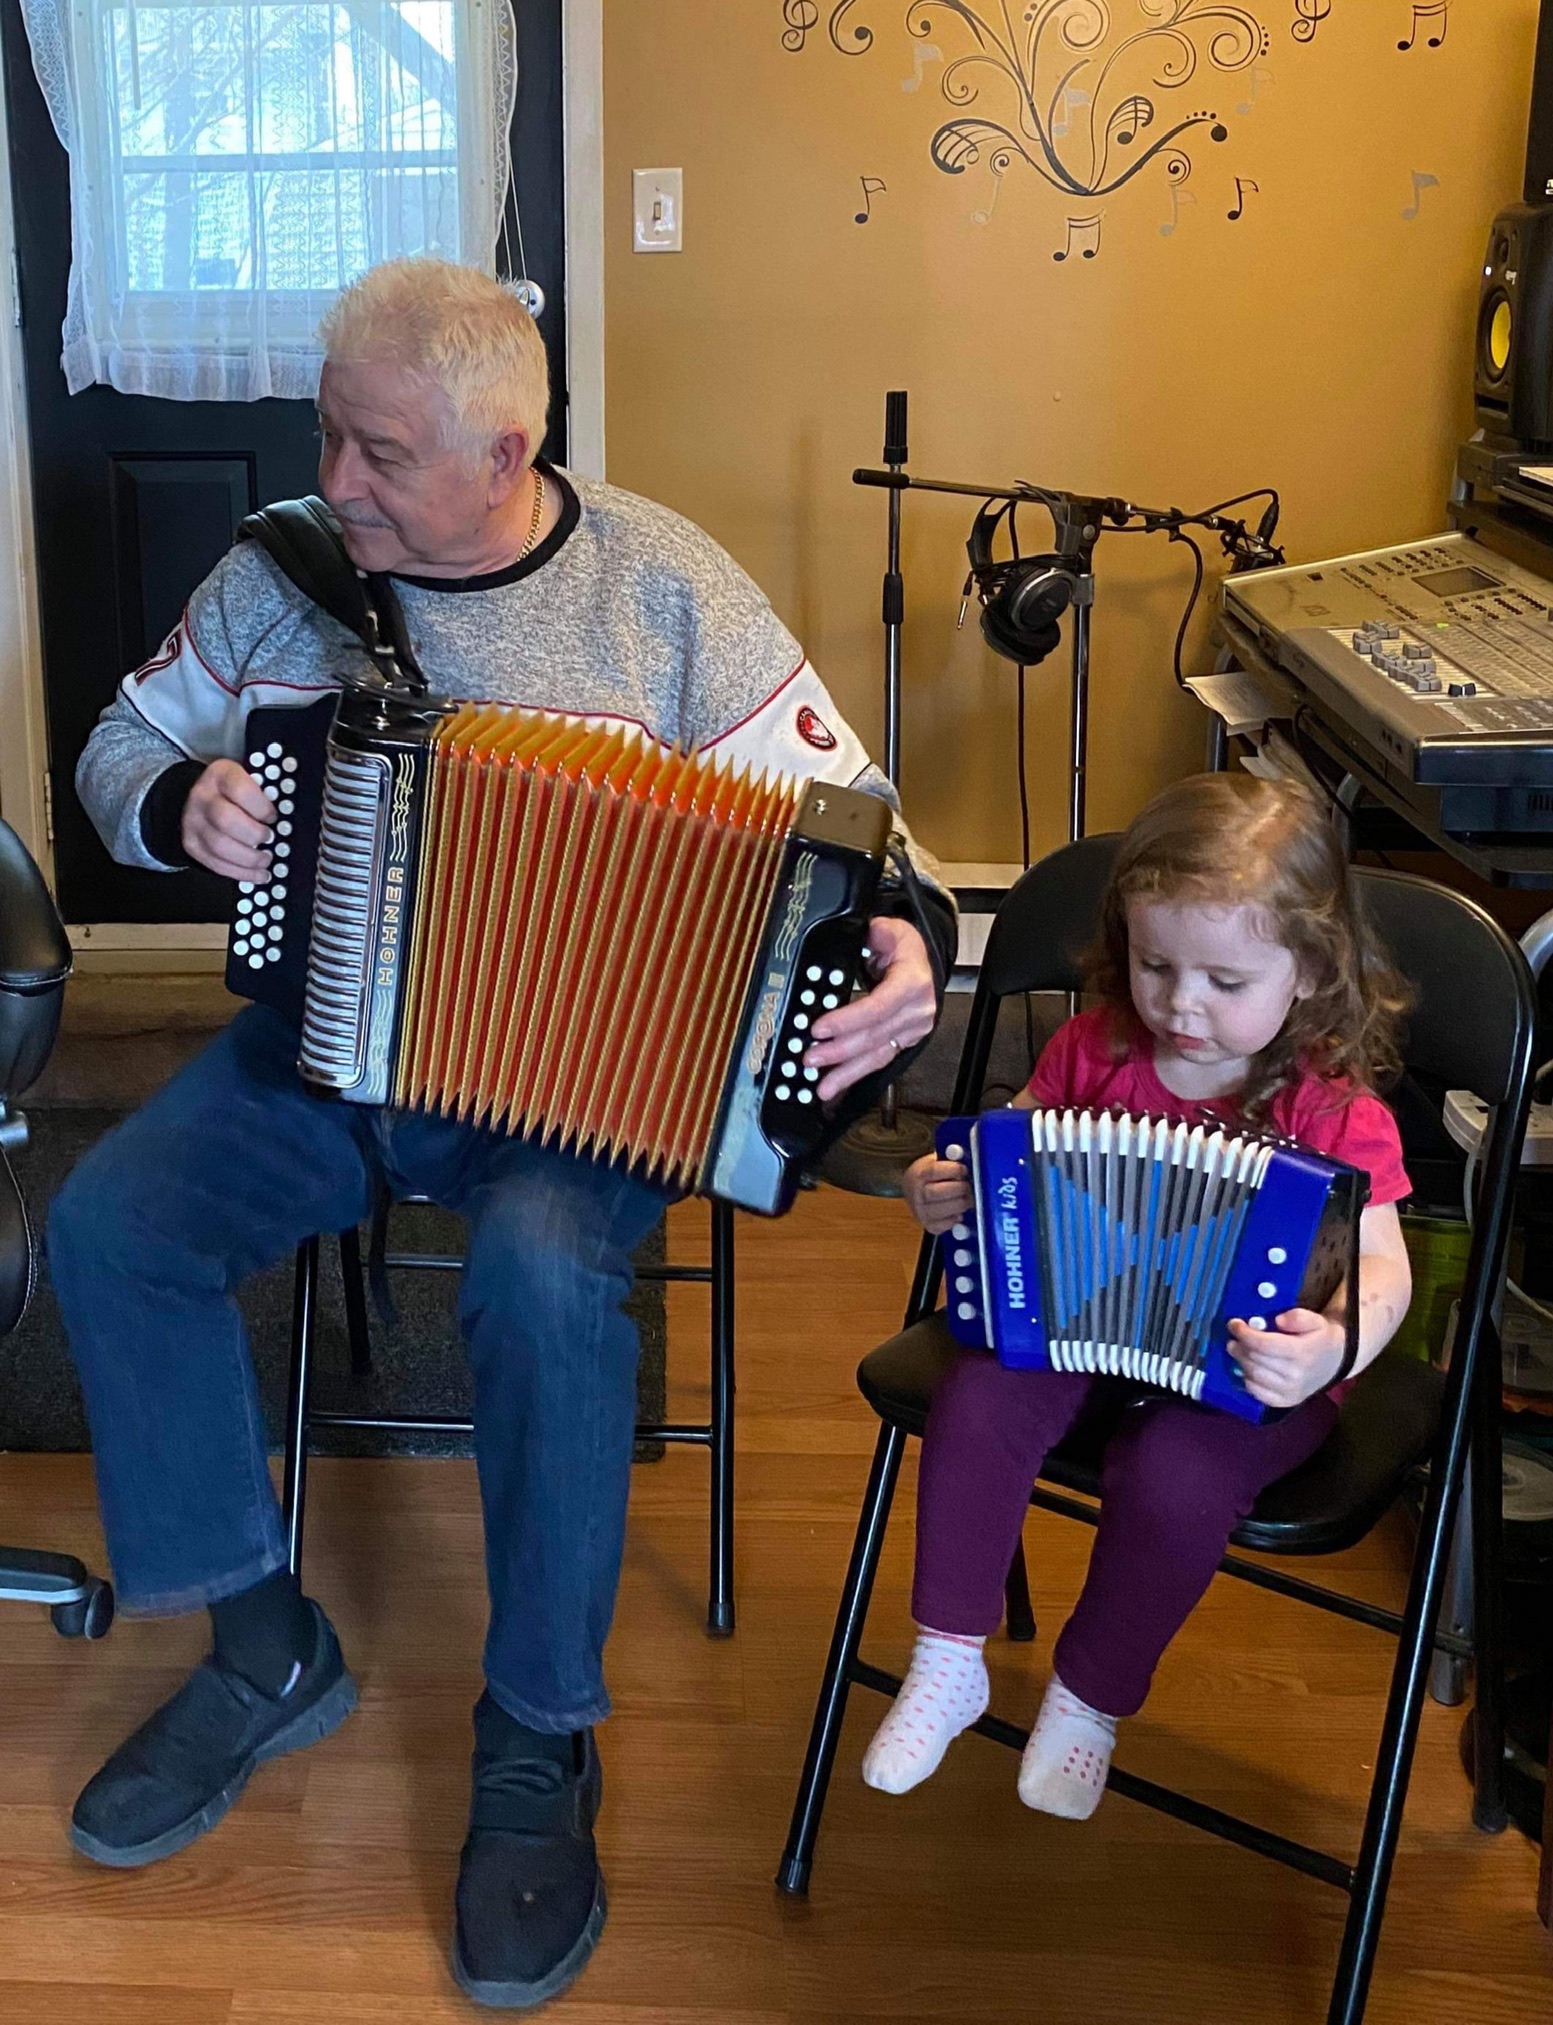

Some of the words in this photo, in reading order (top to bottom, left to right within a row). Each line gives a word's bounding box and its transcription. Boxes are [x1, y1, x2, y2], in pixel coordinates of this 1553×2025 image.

[378, 867, 404, 984] HOHNER
[747, 992, 780, 1075] CORONA
[1003, 1218, 1026, 1308] HOHNER
